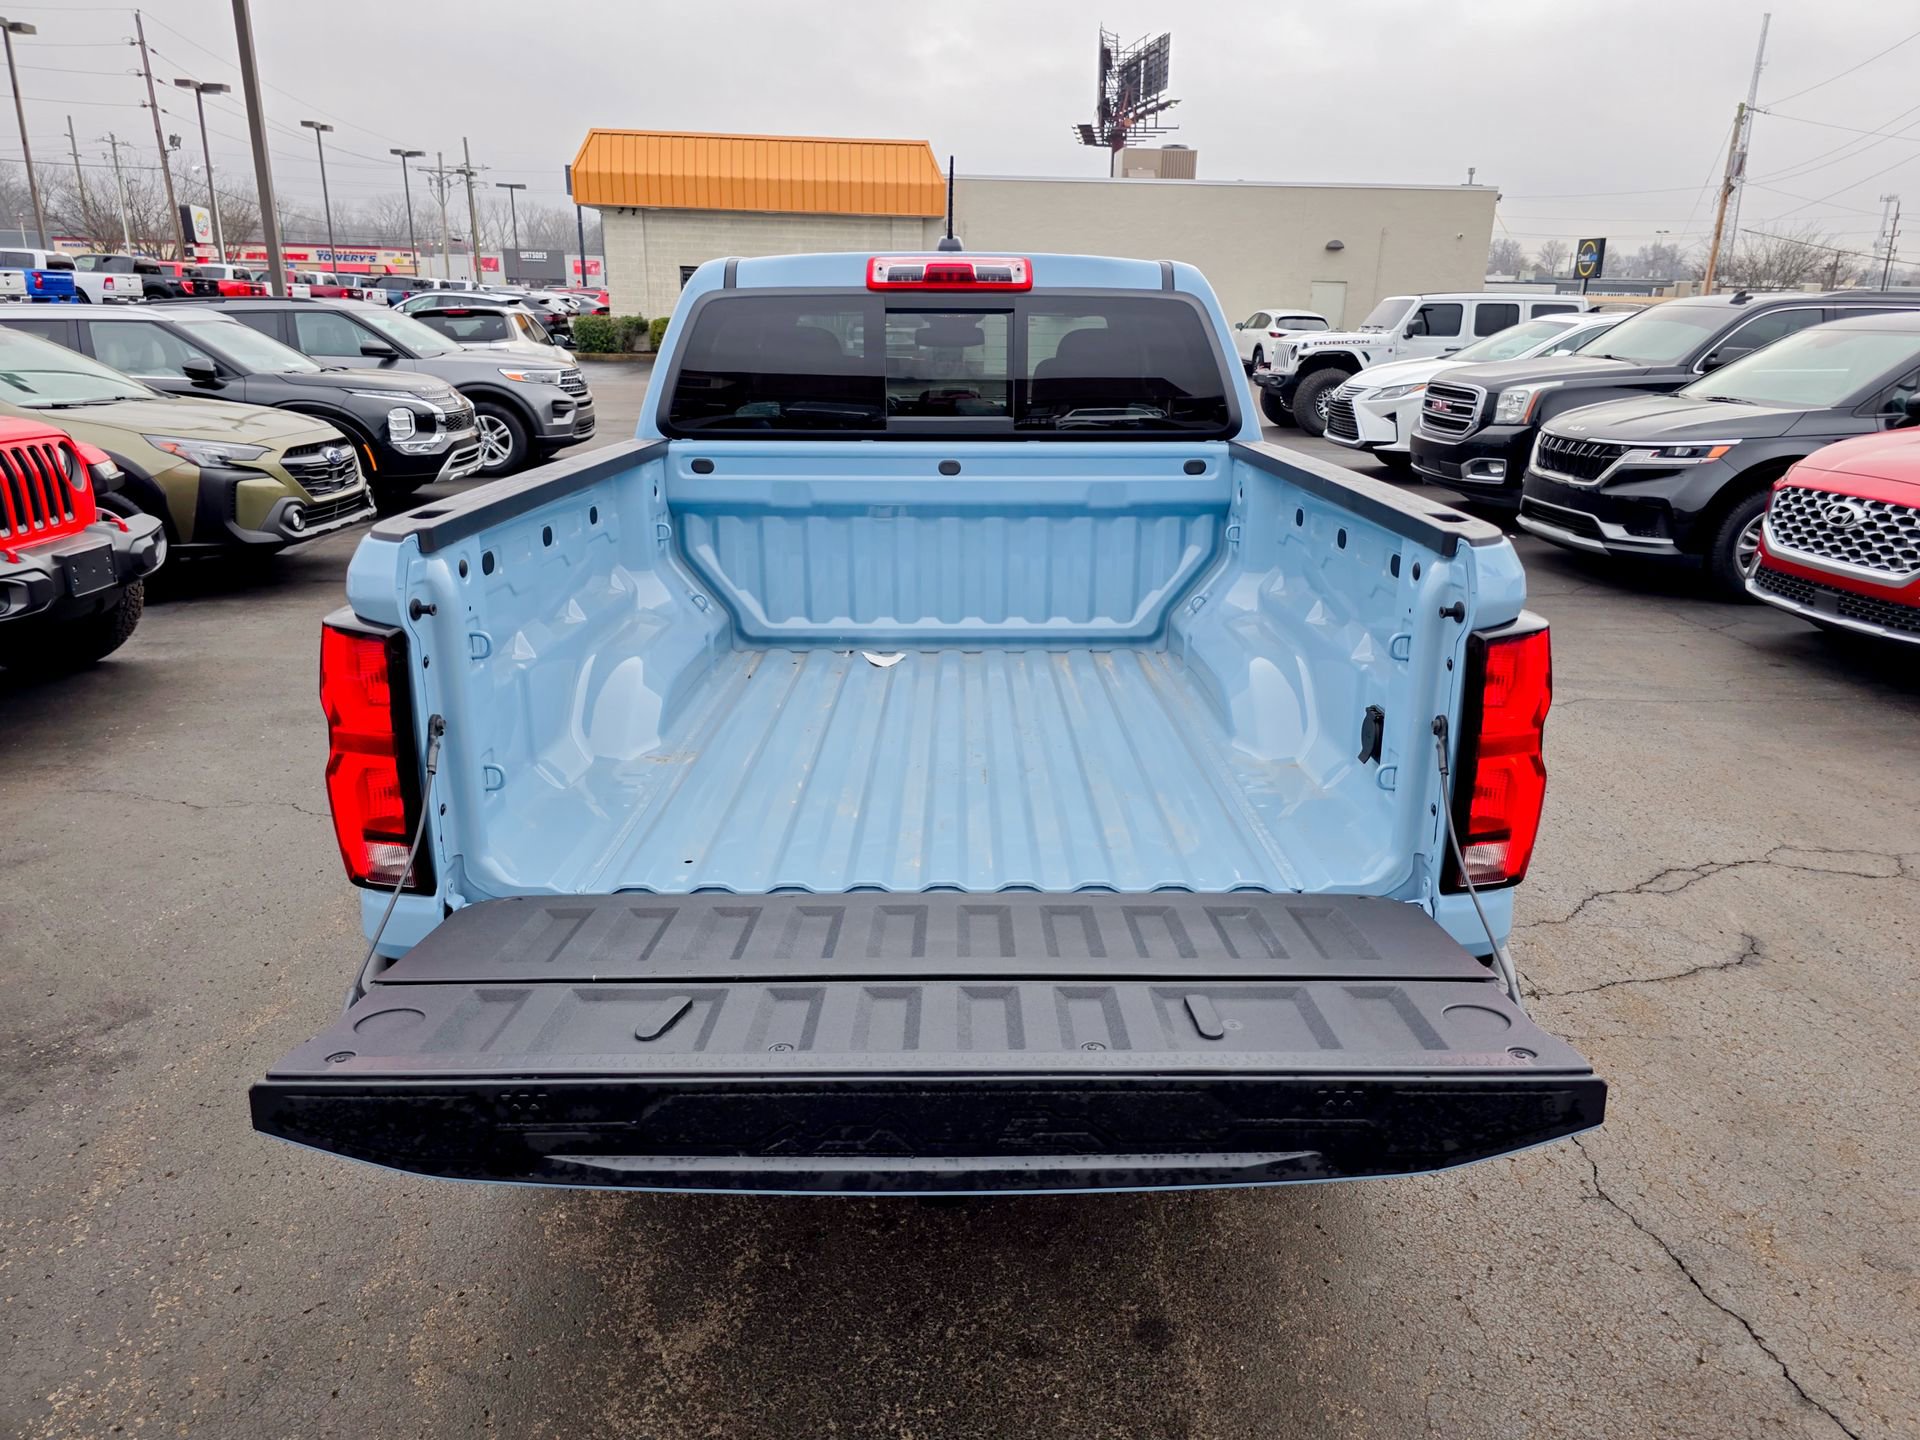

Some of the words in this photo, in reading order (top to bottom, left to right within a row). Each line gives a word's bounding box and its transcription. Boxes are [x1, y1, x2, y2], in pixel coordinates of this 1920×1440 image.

[316, 253, 377, 263] TOWERY'S
[519, 251, 548, 259] WATSON'S
[1431, 400, 1453, 413] GMC
